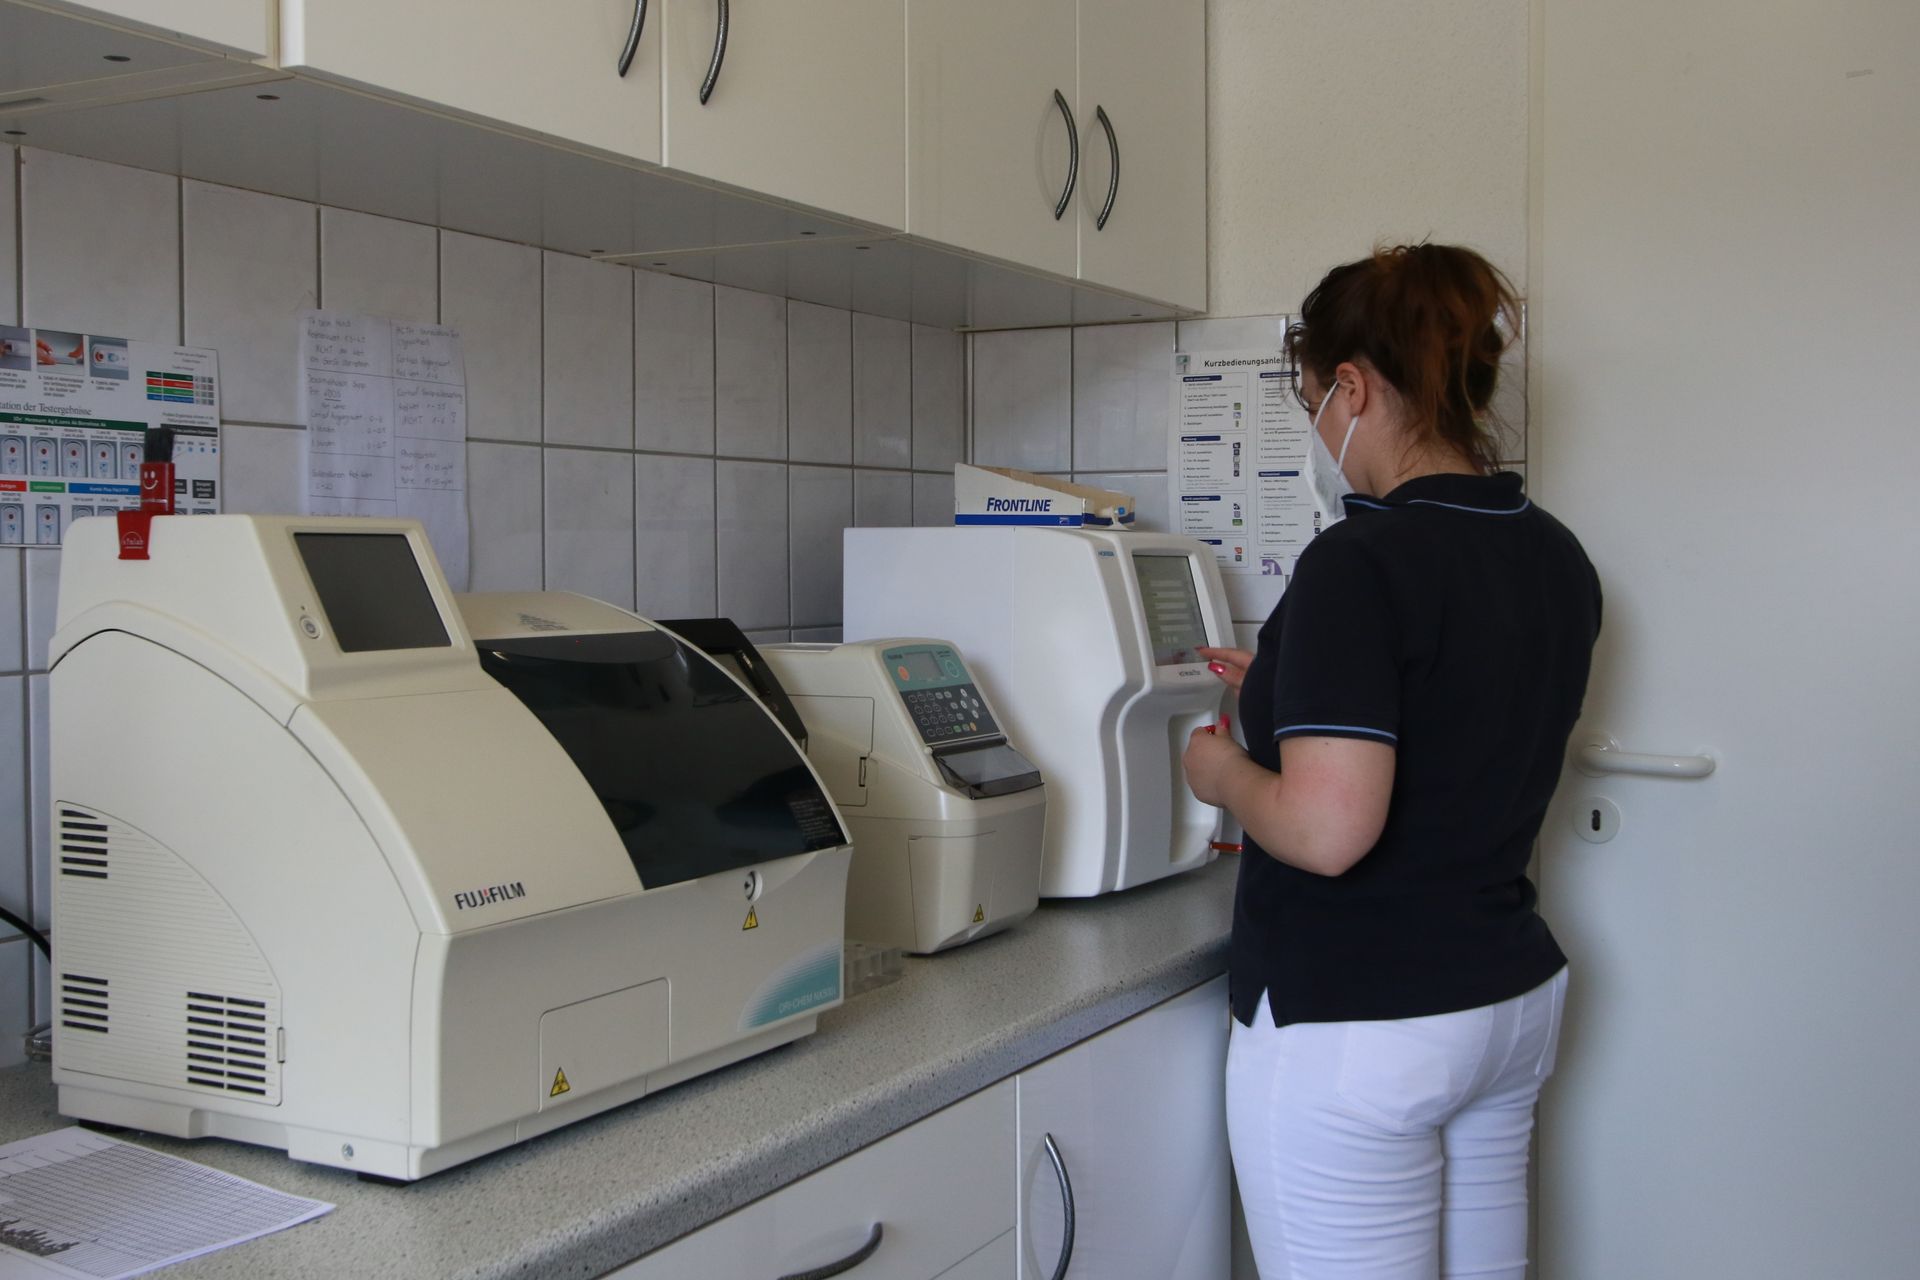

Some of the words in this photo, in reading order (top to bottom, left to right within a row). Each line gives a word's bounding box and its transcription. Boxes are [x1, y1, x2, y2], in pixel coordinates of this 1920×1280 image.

[23, 401, 37, 412] der
[38, 402, 93, 417] Testergebnisse
[986, 496, 1052, 513] FRONTLINE
